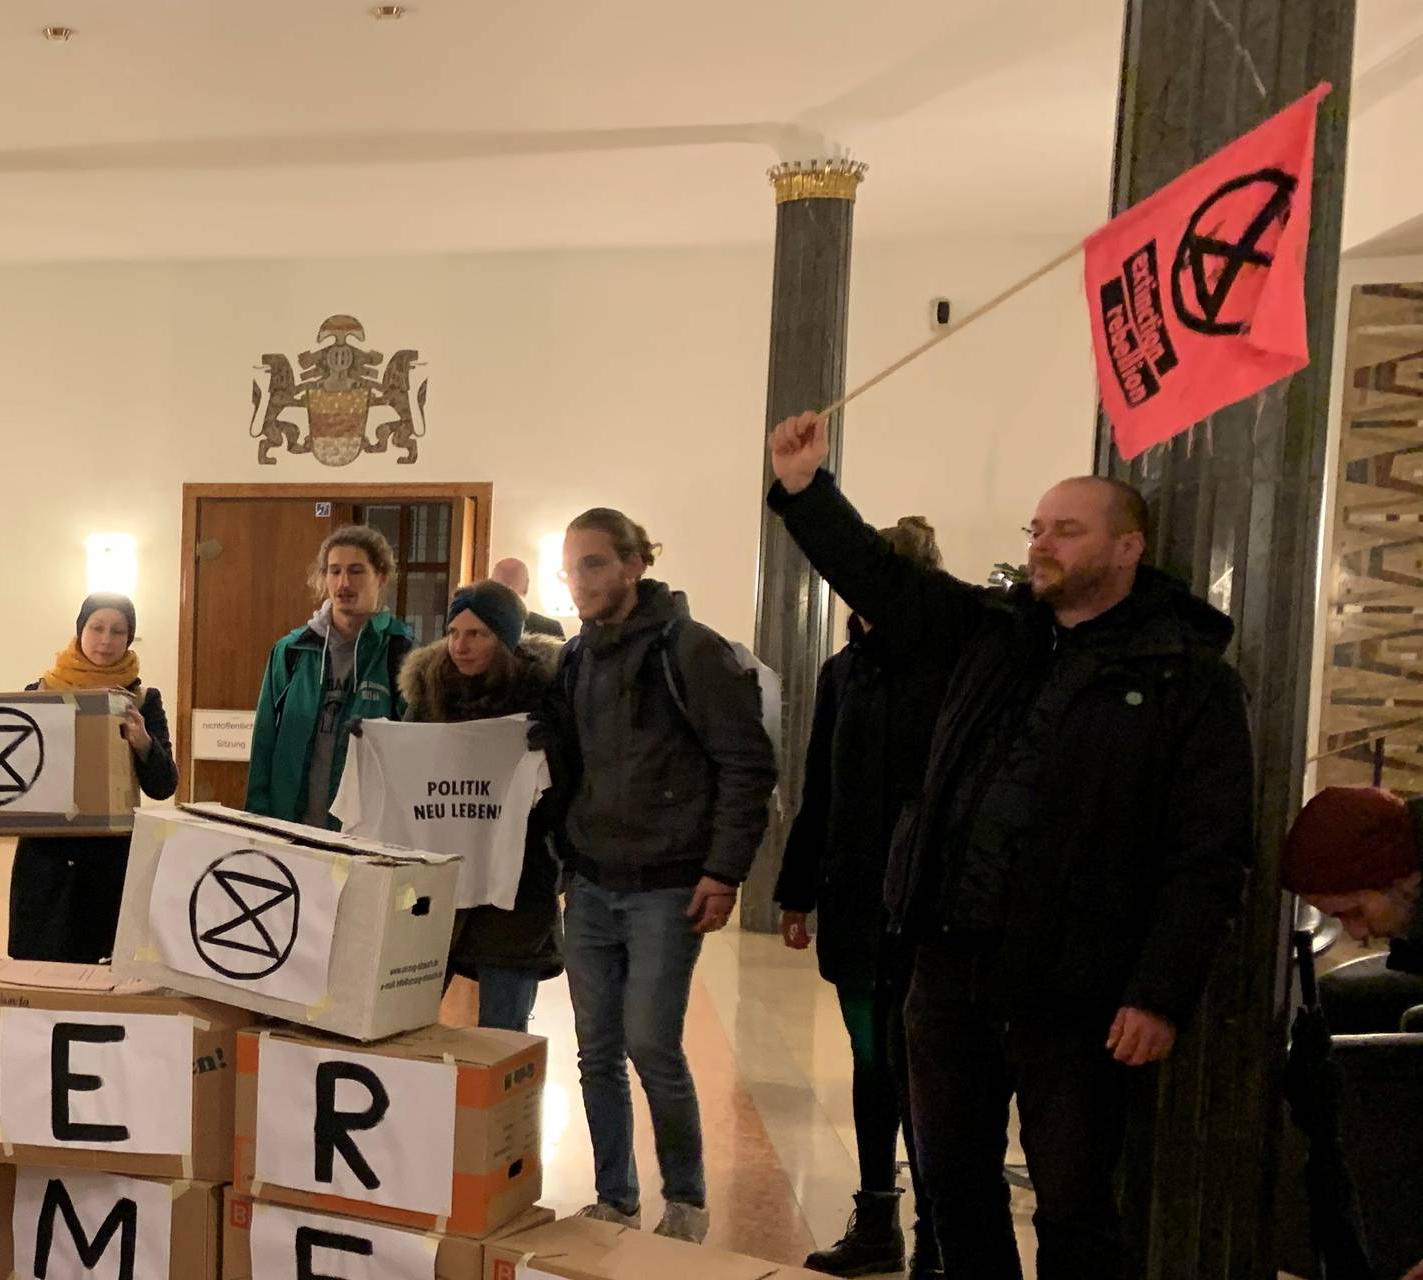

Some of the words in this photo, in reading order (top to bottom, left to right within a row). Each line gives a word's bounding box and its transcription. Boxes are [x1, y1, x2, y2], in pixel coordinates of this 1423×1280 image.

[1131, 251, 1166, 364] extinction
[1106, 303, 1148, 404] rebellion
[216, 739, 246, 749] Sitzung
[427, 780, 491, 796] POLITIK
[413, 803, 446, 820] NEU
[451, 803, 502, 820] LEBEN!
